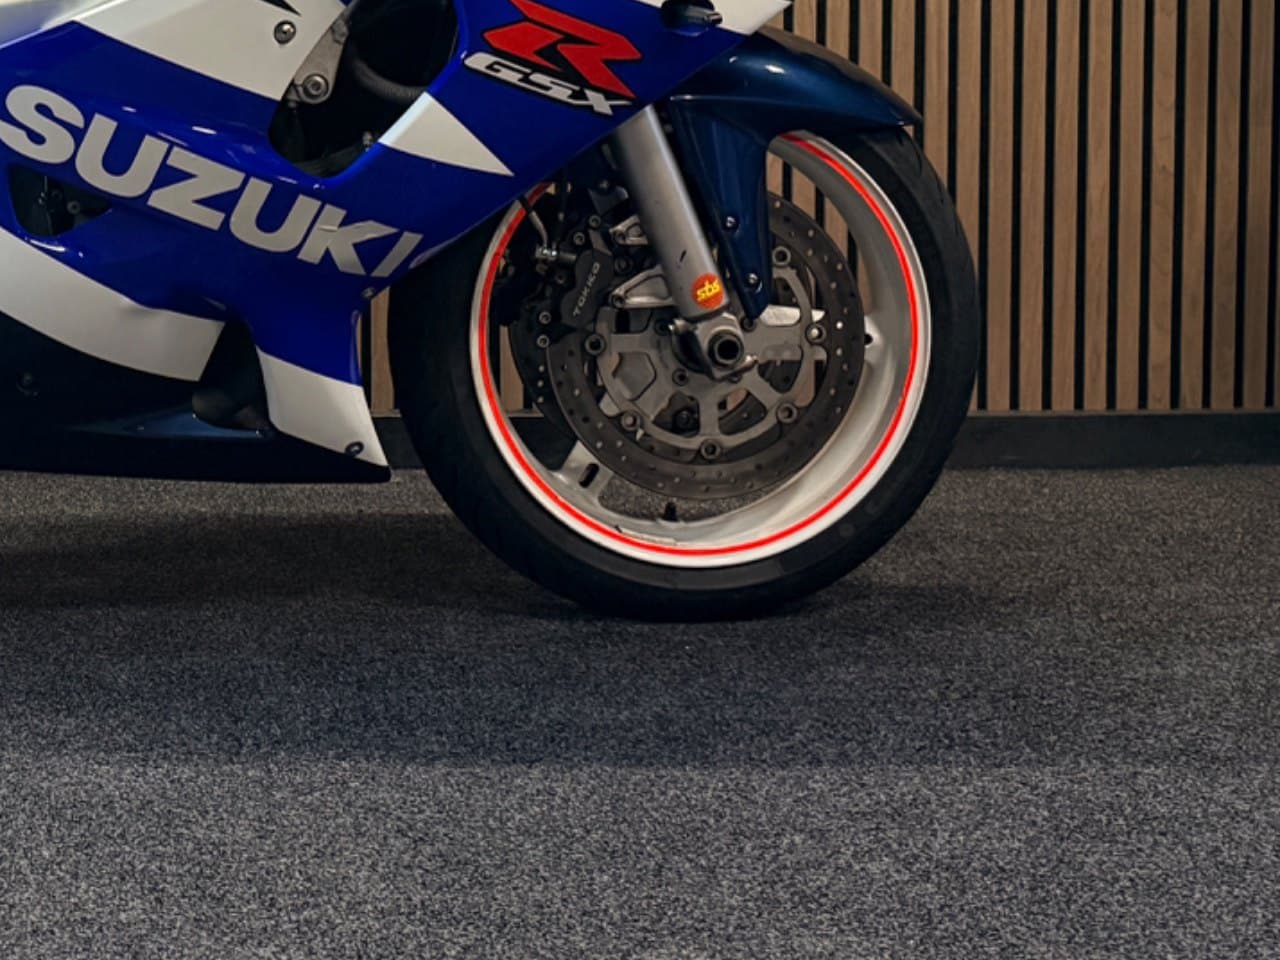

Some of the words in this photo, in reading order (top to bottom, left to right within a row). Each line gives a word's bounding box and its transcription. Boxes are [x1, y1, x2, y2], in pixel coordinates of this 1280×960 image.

[463, 51, 633, 116] GSX
[573, 261, 601, 317] TOKICO
[696, 279, 721, 302] sbs
